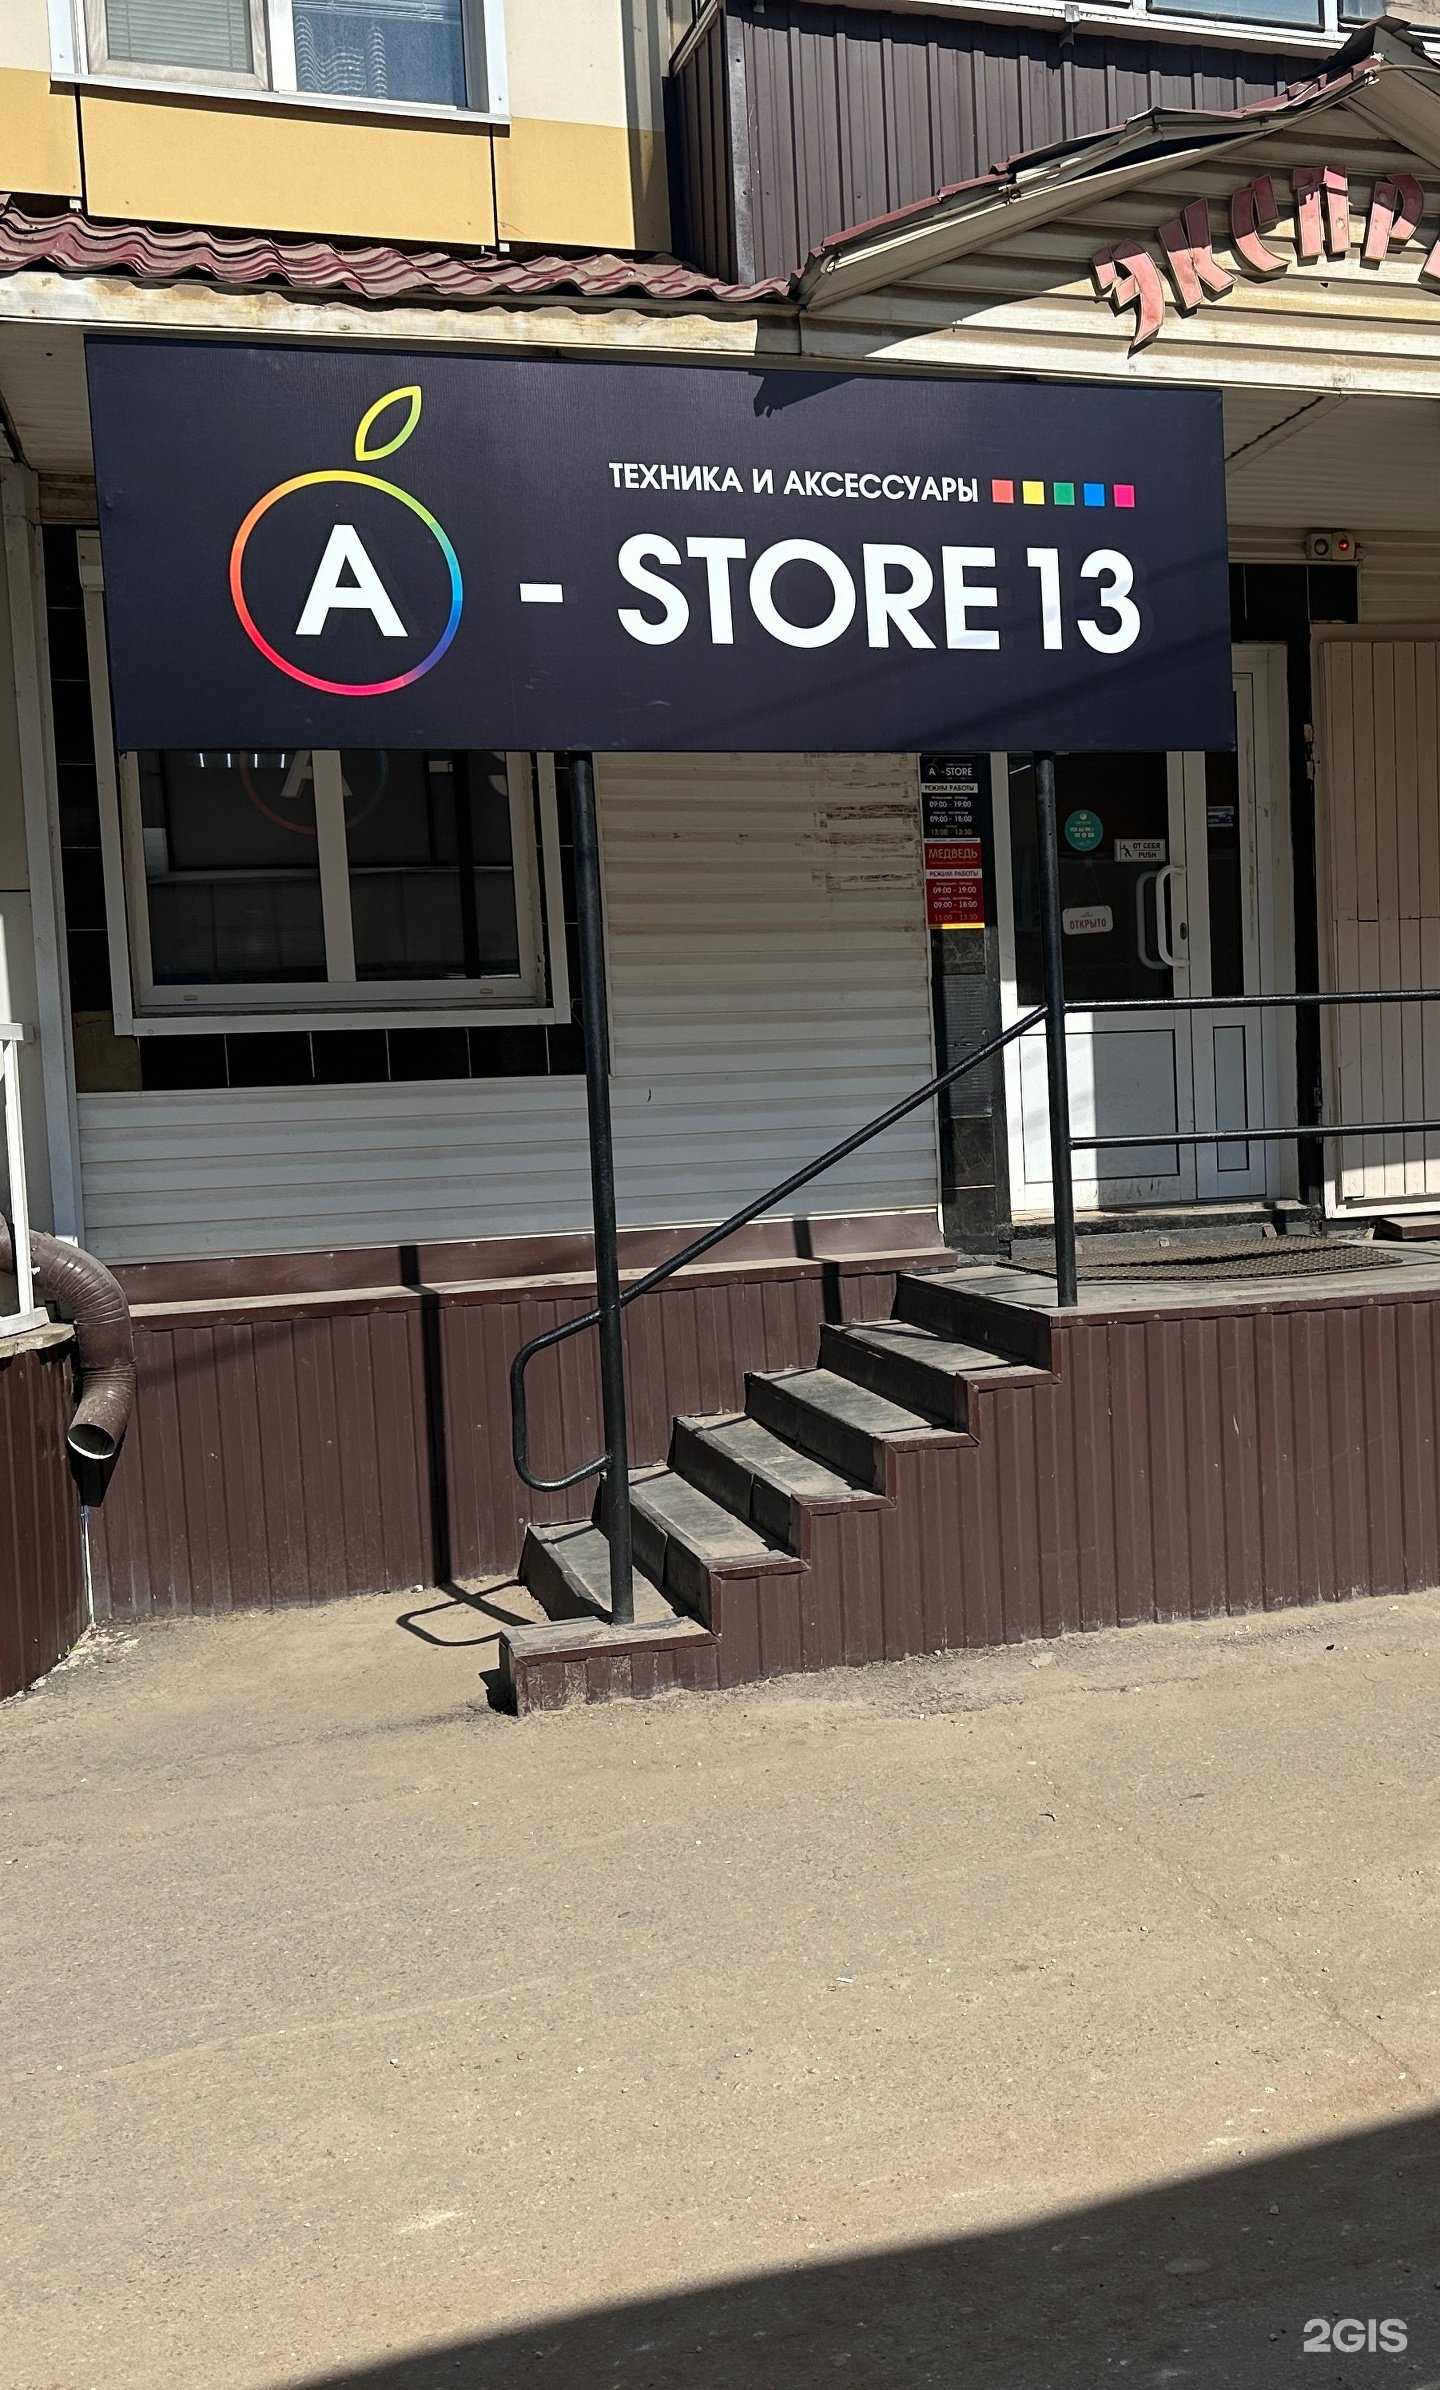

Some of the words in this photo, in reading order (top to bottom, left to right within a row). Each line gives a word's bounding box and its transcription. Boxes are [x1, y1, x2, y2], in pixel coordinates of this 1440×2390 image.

[608, 462, 744, 493] ТЕХНИКА
[752, 468, 774, 494] И
[783, 470, 979, 503] АКСЕССУАРЫ
[295, 524, 409, 637] A
[617, 533, 1001, 651] STORE
[1026, 546, 1142, 655] 13
[928, 848, 978, 859] МЕДВЕДЬ
[1069, 918, 1107, 930] ОТКРЫТО
